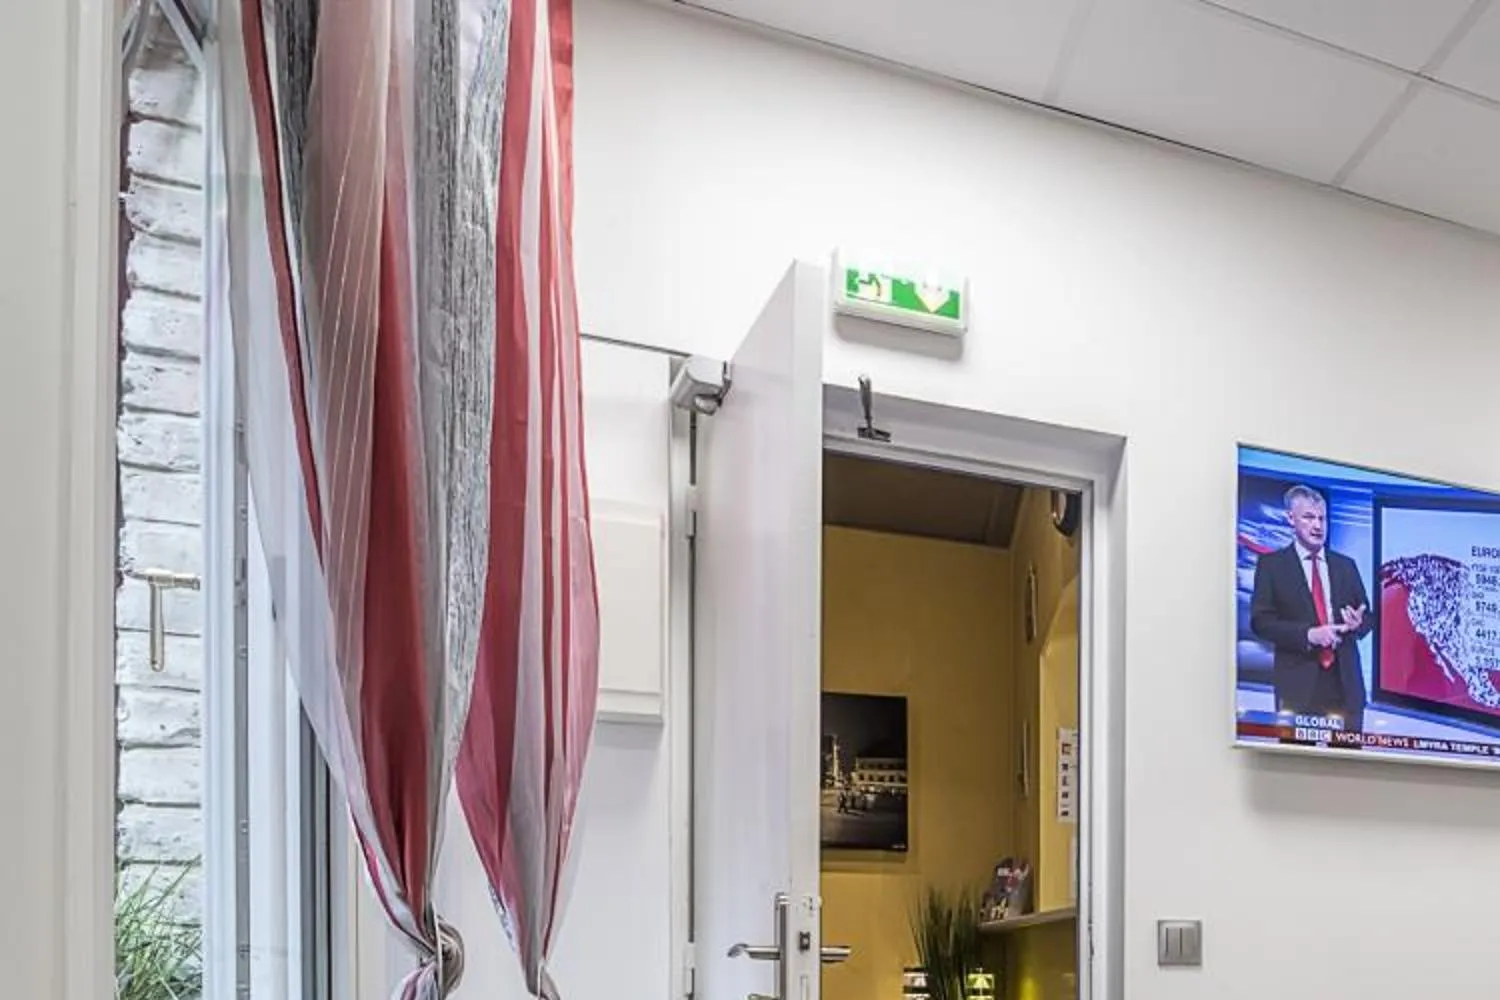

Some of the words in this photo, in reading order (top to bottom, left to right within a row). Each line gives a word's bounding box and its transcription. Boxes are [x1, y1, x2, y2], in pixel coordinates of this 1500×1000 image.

[1295, 715, 1341, 730] GLOBAL
[1335, 731, 1376, 745] WORLD
[1379, 735, 1409, 747] NEWS
